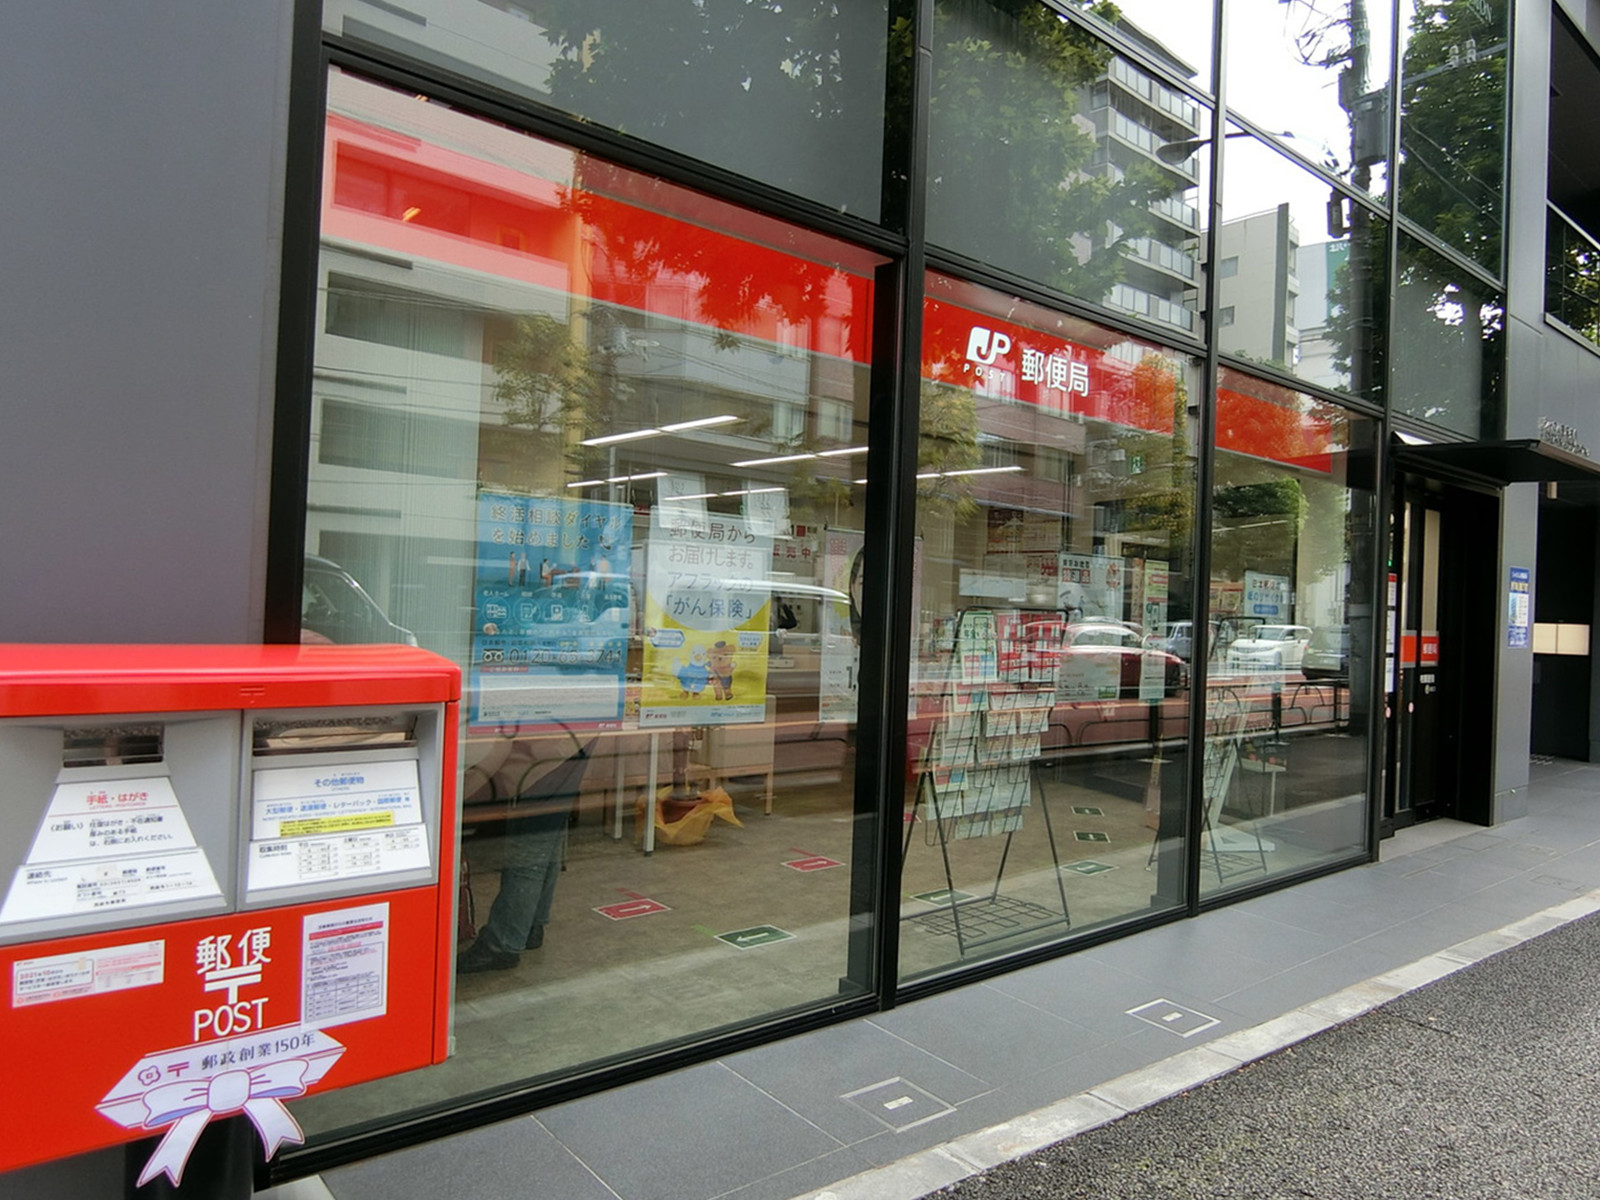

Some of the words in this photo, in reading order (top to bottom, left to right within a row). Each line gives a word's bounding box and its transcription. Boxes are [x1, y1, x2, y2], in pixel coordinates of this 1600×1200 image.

[963, 363, 1006, 382] POST
[1021, 348, 1089, 397] 郵便局
[491, 504, 621, 529] 終活相談ダイヤル
[491, 527, 589, 550] を始めました
[669, 518, 756, 544] 郵便局から
[668, 545, 754, 569] お届けします。
[666, 594, 753, 620] 「がん保険」
[196, 926, 272, 975] 郵便
[194, 997, 269, 1042] POST
[201, 1032, 316, 1071] 郵政創業150年
